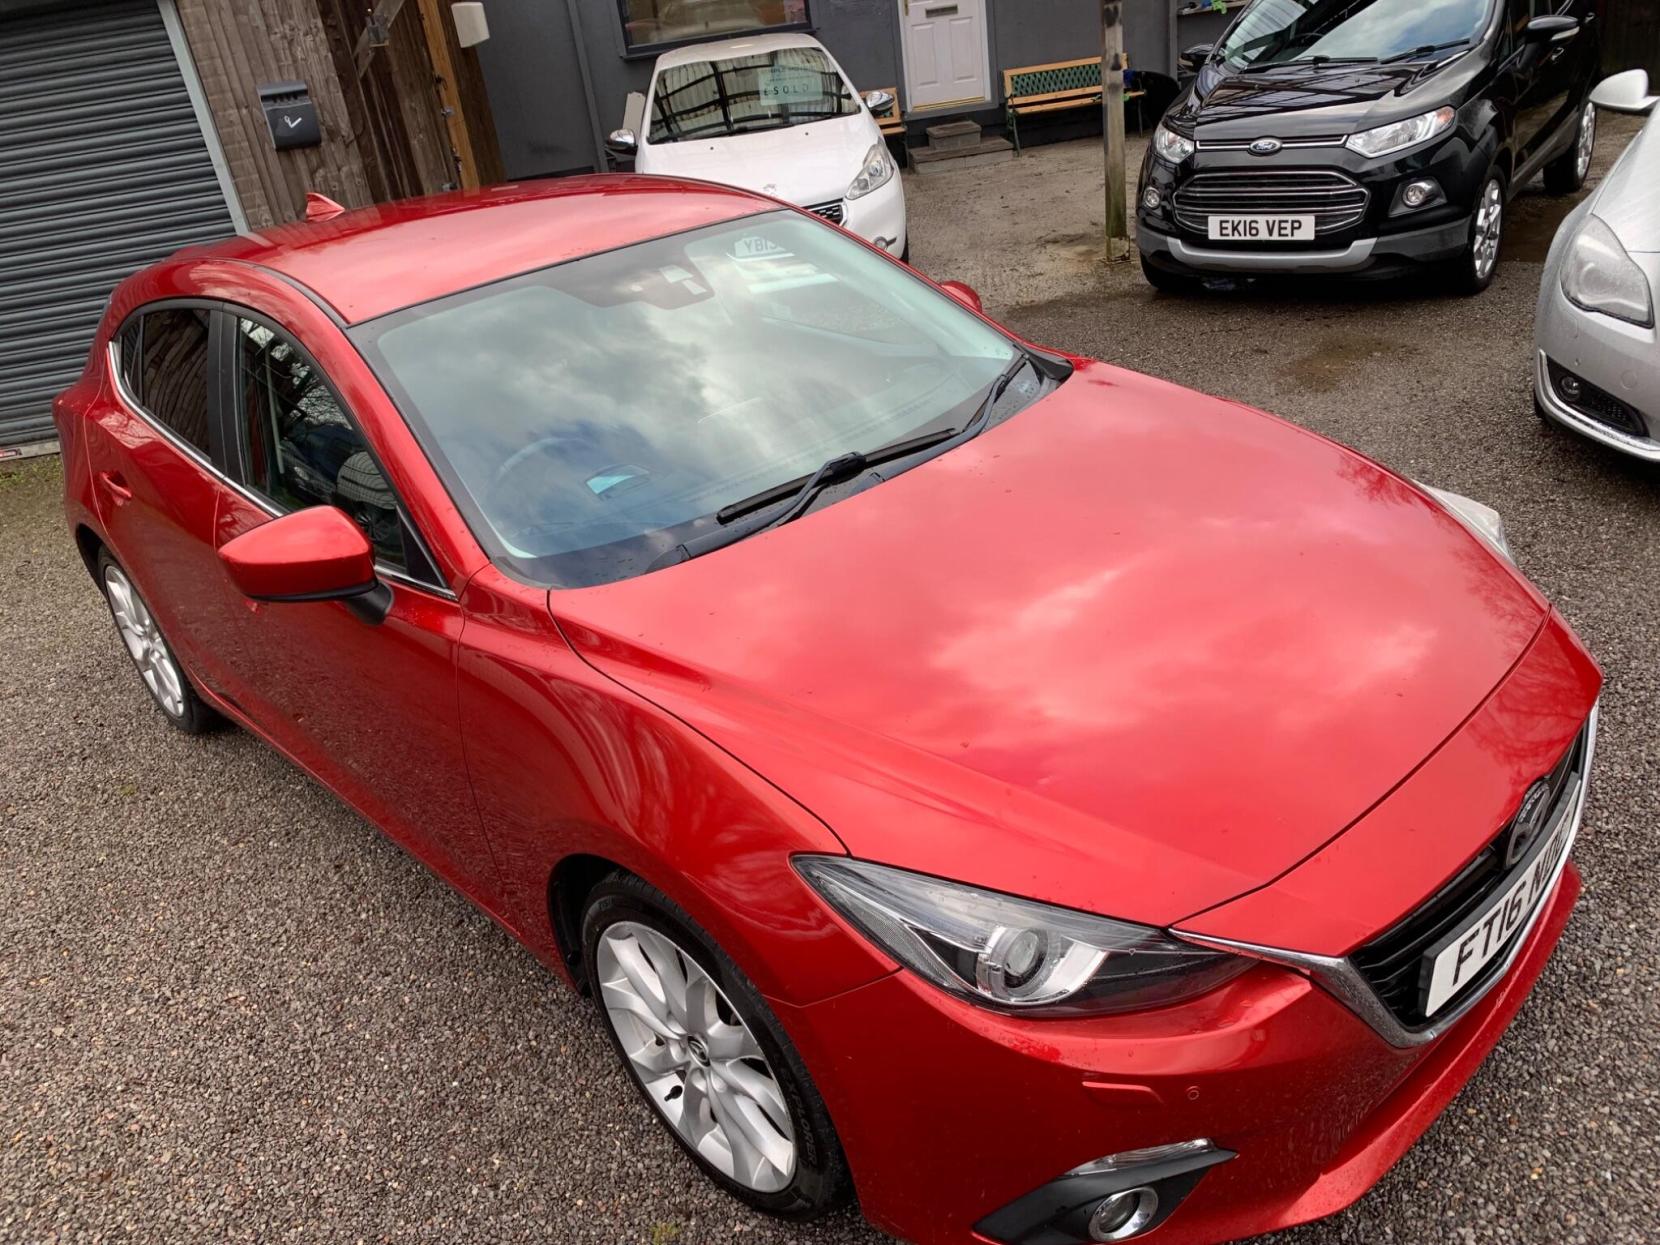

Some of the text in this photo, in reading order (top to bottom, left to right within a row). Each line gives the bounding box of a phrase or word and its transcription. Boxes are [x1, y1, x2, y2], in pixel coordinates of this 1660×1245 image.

[773, 83, 809, 95] SOLD
[1219, 219, 1302, 237] EK16 VEP
[1452, 880, 1527, 987] FT16
